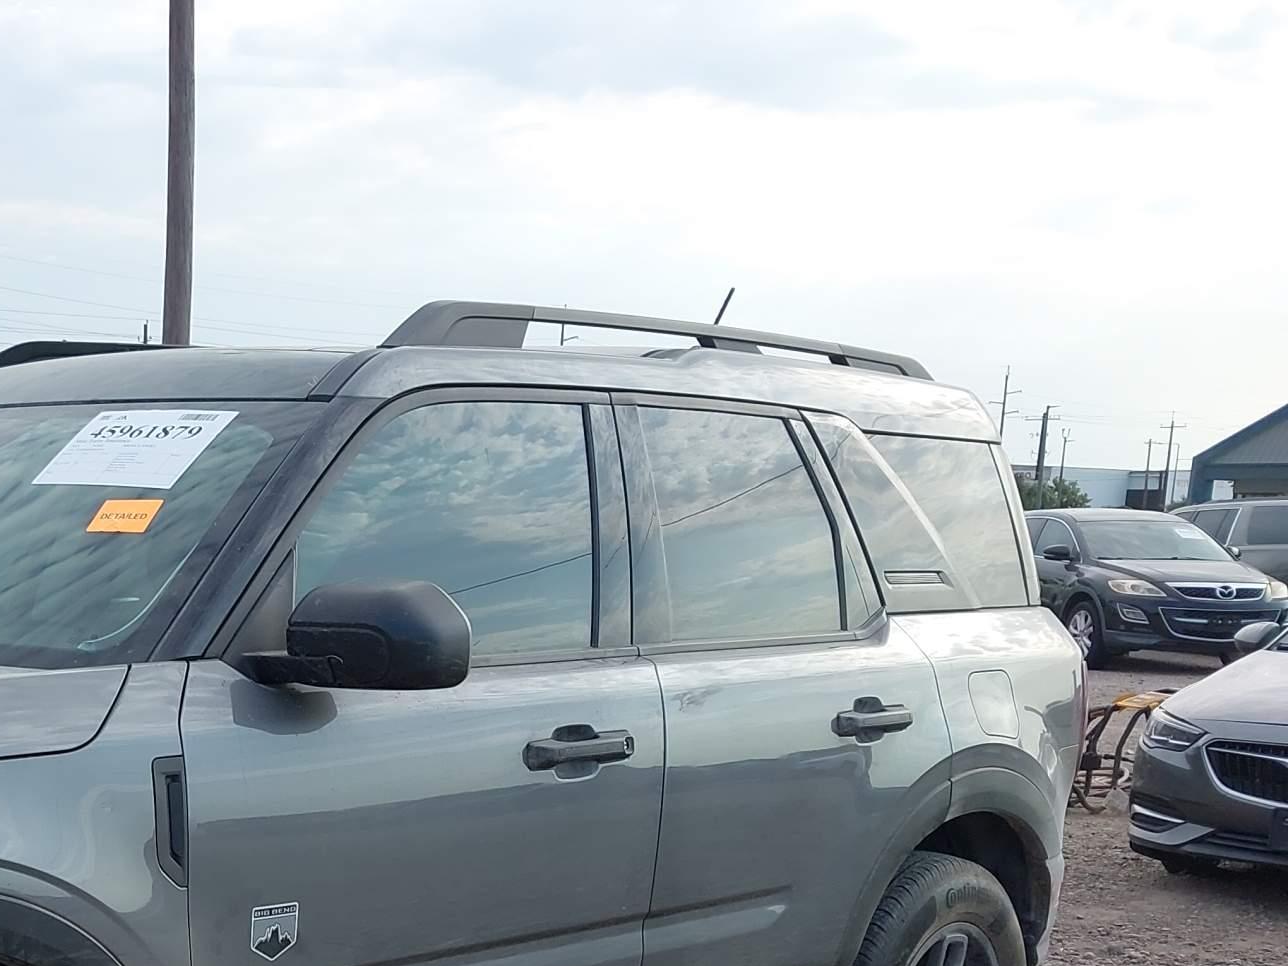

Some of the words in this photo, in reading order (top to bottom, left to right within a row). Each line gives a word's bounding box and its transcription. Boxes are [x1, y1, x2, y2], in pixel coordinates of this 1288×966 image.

[90, 424, 203, 440] 45961879
[99, 512, 148, 520] DETAILED
[272, 906, 296, 914] BEND
